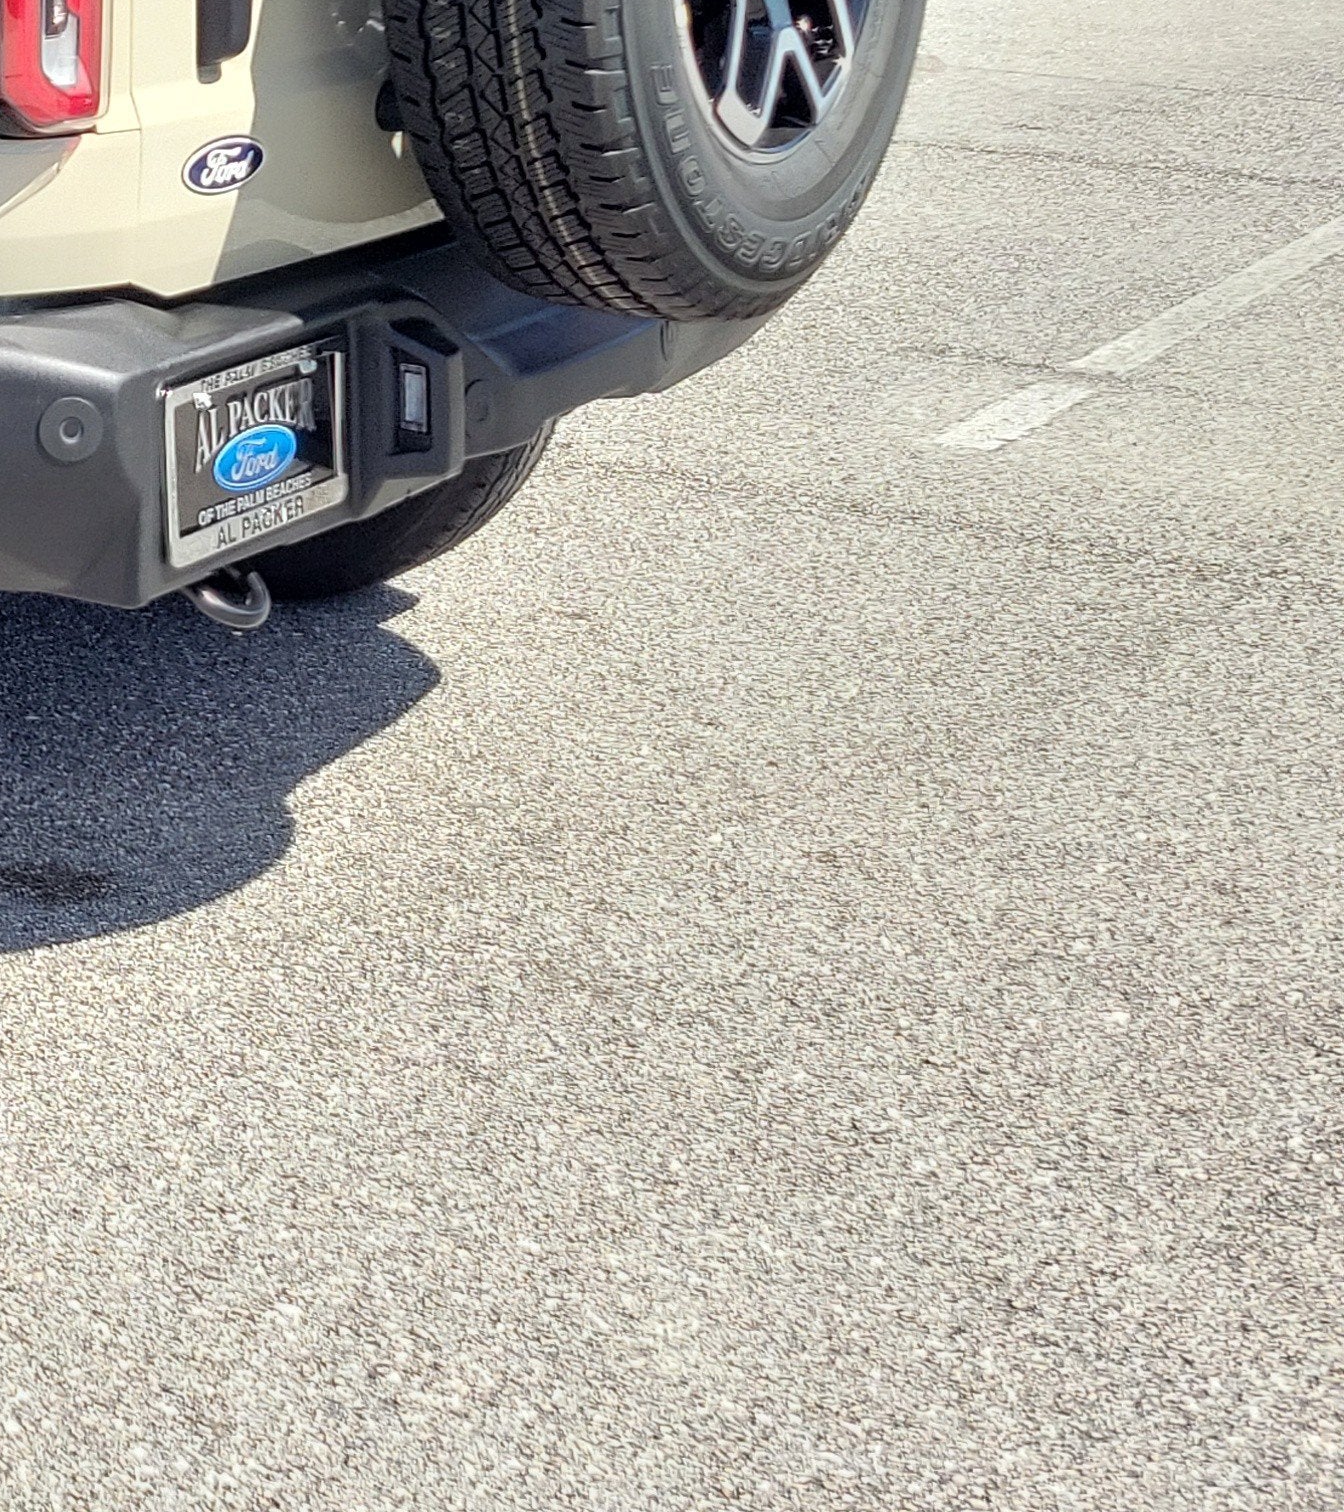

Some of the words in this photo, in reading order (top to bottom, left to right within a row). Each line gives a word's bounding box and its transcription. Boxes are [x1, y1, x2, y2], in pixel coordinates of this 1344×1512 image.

[200, 146, 255, 187] Ford
[200, 376, 223, 393] THE
[194, 407, 224, 475] AL
[227, 377, 317, 439] PACKER
[231, 437, 281, 482] Ford
[198, 508, 215, 527] OF
[214, 498, 236, 522] THE
[236, 488, 263, 513] PALM
[265, 472, 313, 503] BEACHES
[216, 522, 238, 550] AL
[241, 494, 305, 540] PACKER
